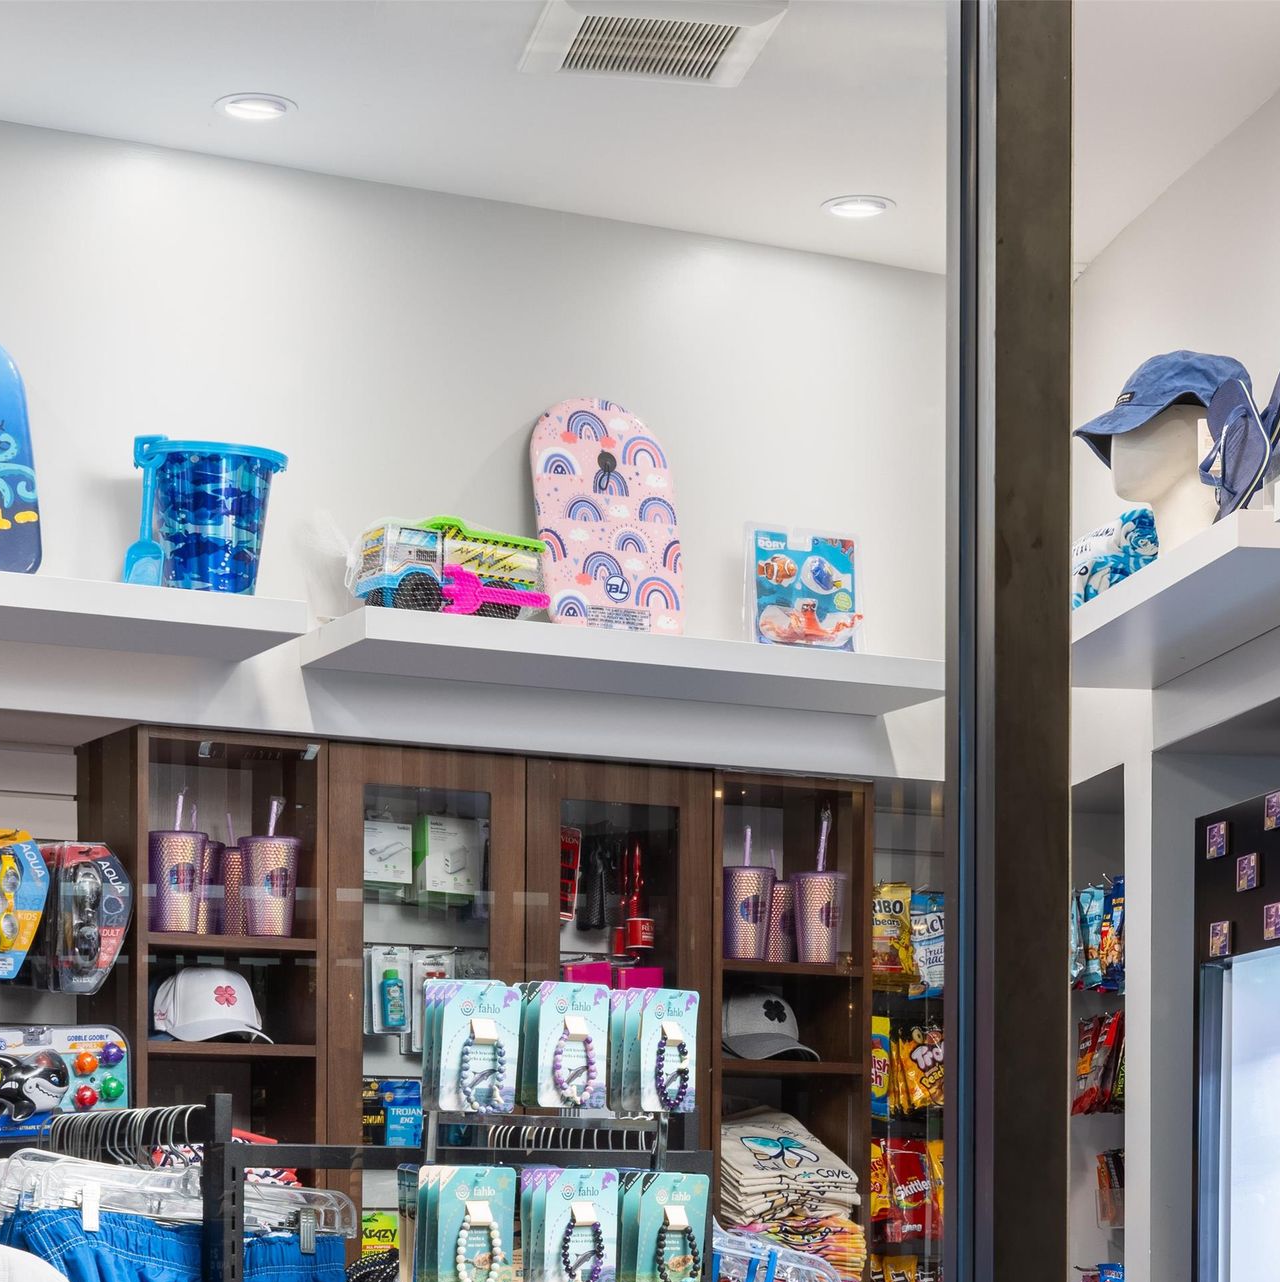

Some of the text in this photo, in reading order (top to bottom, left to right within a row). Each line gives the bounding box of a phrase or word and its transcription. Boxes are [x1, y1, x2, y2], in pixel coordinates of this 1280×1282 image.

[757, 537, 786, 550] DORY
[19, 843, 46, 879] AQUA
[97, 860, 126, 894] AQUA
[872, 899, 904, 915] RIBO
[17, 912, 38, 921] KIDS
[101, 928, 121, 937] DULT
[925, 945, 944, 957] Frui
[919, 954, 944, 968] Snac
[478, 1002, 501, 1014] fahlo
[571, 1001, 592, 1012] fahlo
[666, 1006, 684, 1018] fahlo
[390, 1107, 423, 1116] TROJAN
[362, 1115, 385, 1124] GNUM
[473, 1187, 496, 1197] fahlo
[578, 1187, 600, 1197] fahlo
[671, 1191, 691, 1202] fahlo
